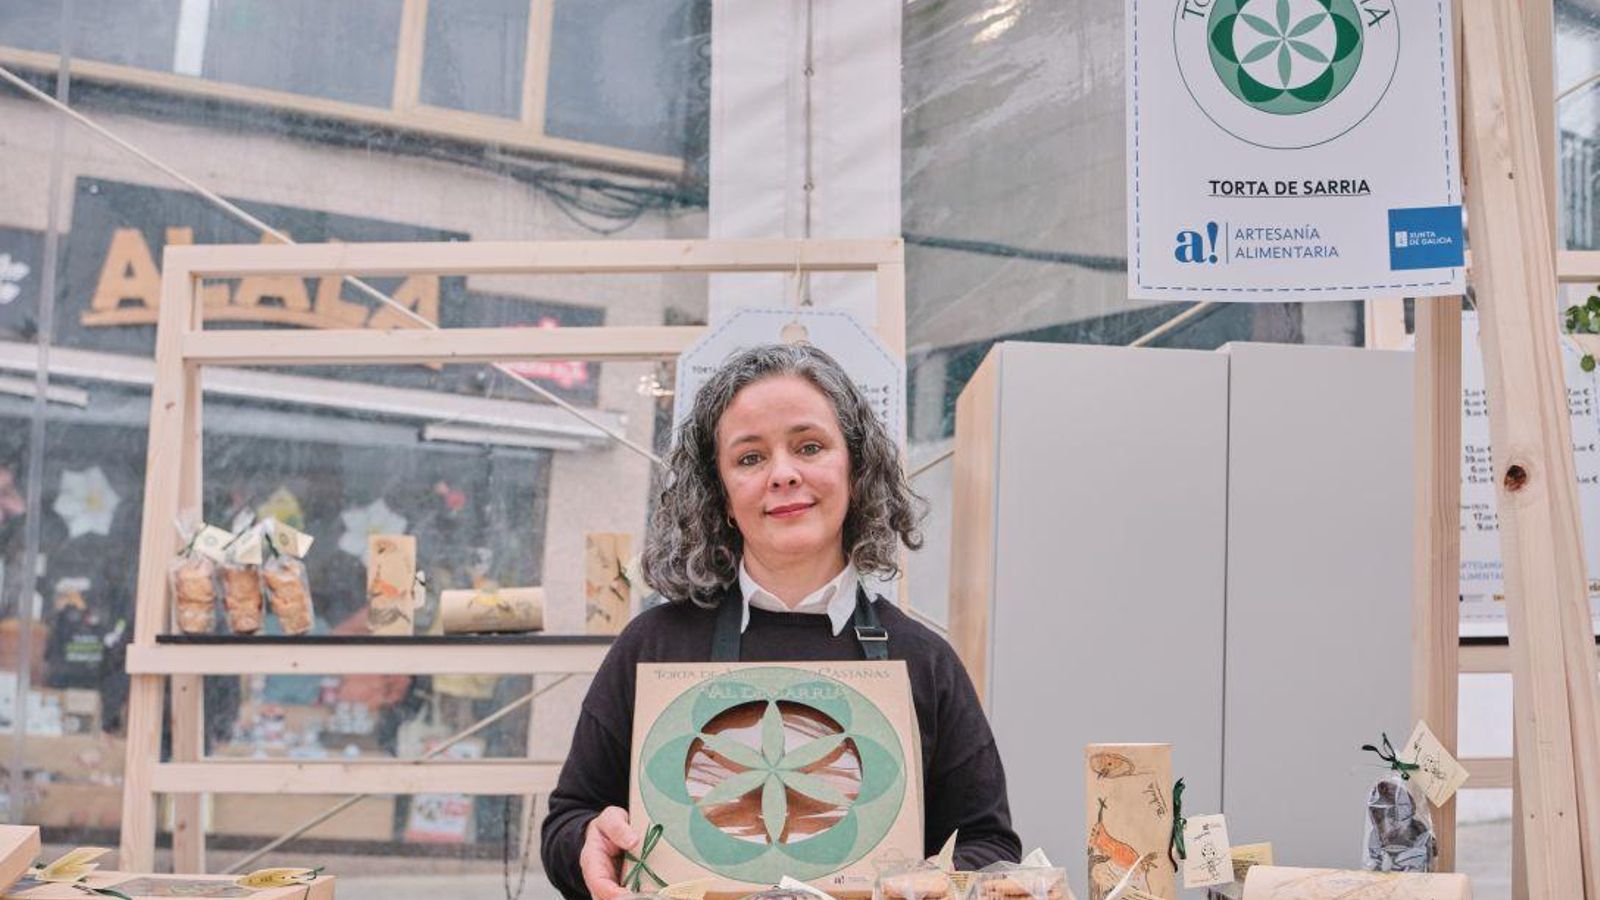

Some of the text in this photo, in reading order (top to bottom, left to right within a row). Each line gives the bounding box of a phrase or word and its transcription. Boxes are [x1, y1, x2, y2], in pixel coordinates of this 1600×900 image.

[1208, 180, 1371, 195] TORTA DE SARRIA
[1234, 224, 1320, 241] ARTESANÍA
[1174, 220, 1219, 264] a!
[1421, 236, 1453, 245] GALICIA
[1234, 245, 1339, 259] ALIMENTARIA
